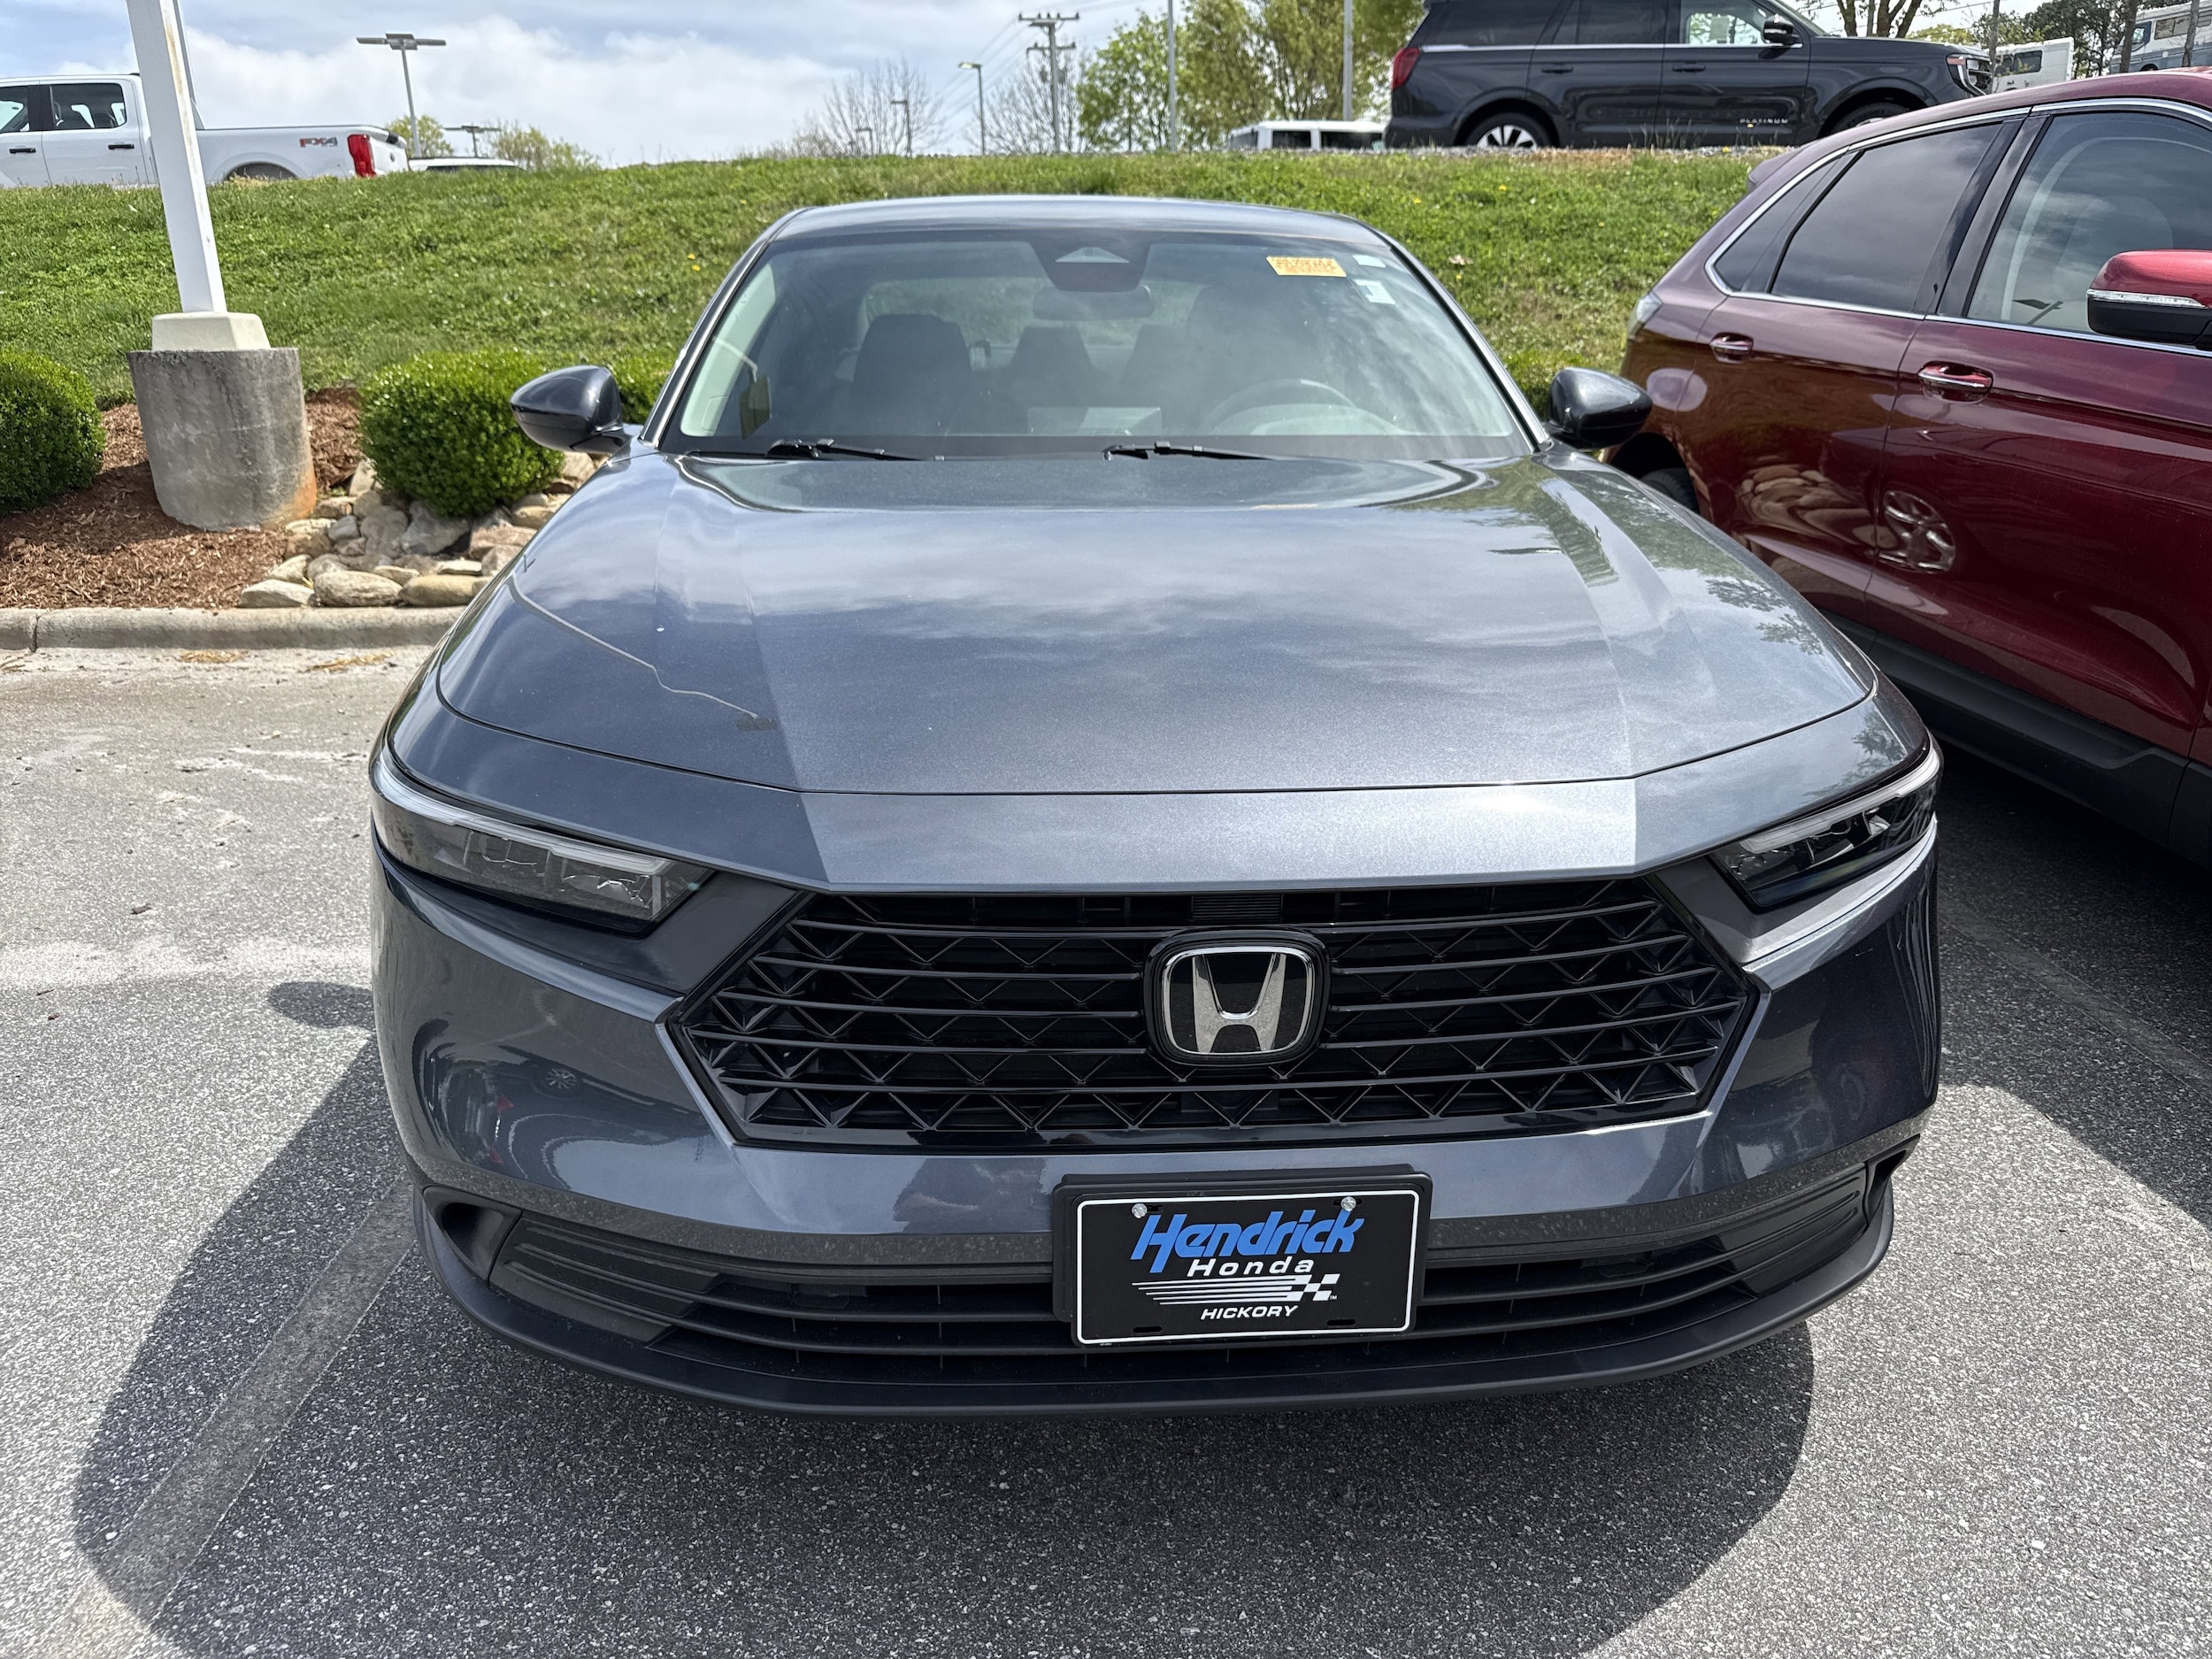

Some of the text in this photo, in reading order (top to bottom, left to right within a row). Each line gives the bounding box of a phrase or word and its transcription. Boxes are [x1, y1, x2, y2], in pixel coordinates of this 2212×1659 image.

[299, 137, 338, 148] FX4
[1130, 1209, 1365, 1273] Hendrick
[1187, 1257, 1315, 1277] Honda
[1201, 1305, 1299, 1320] HICKORY
